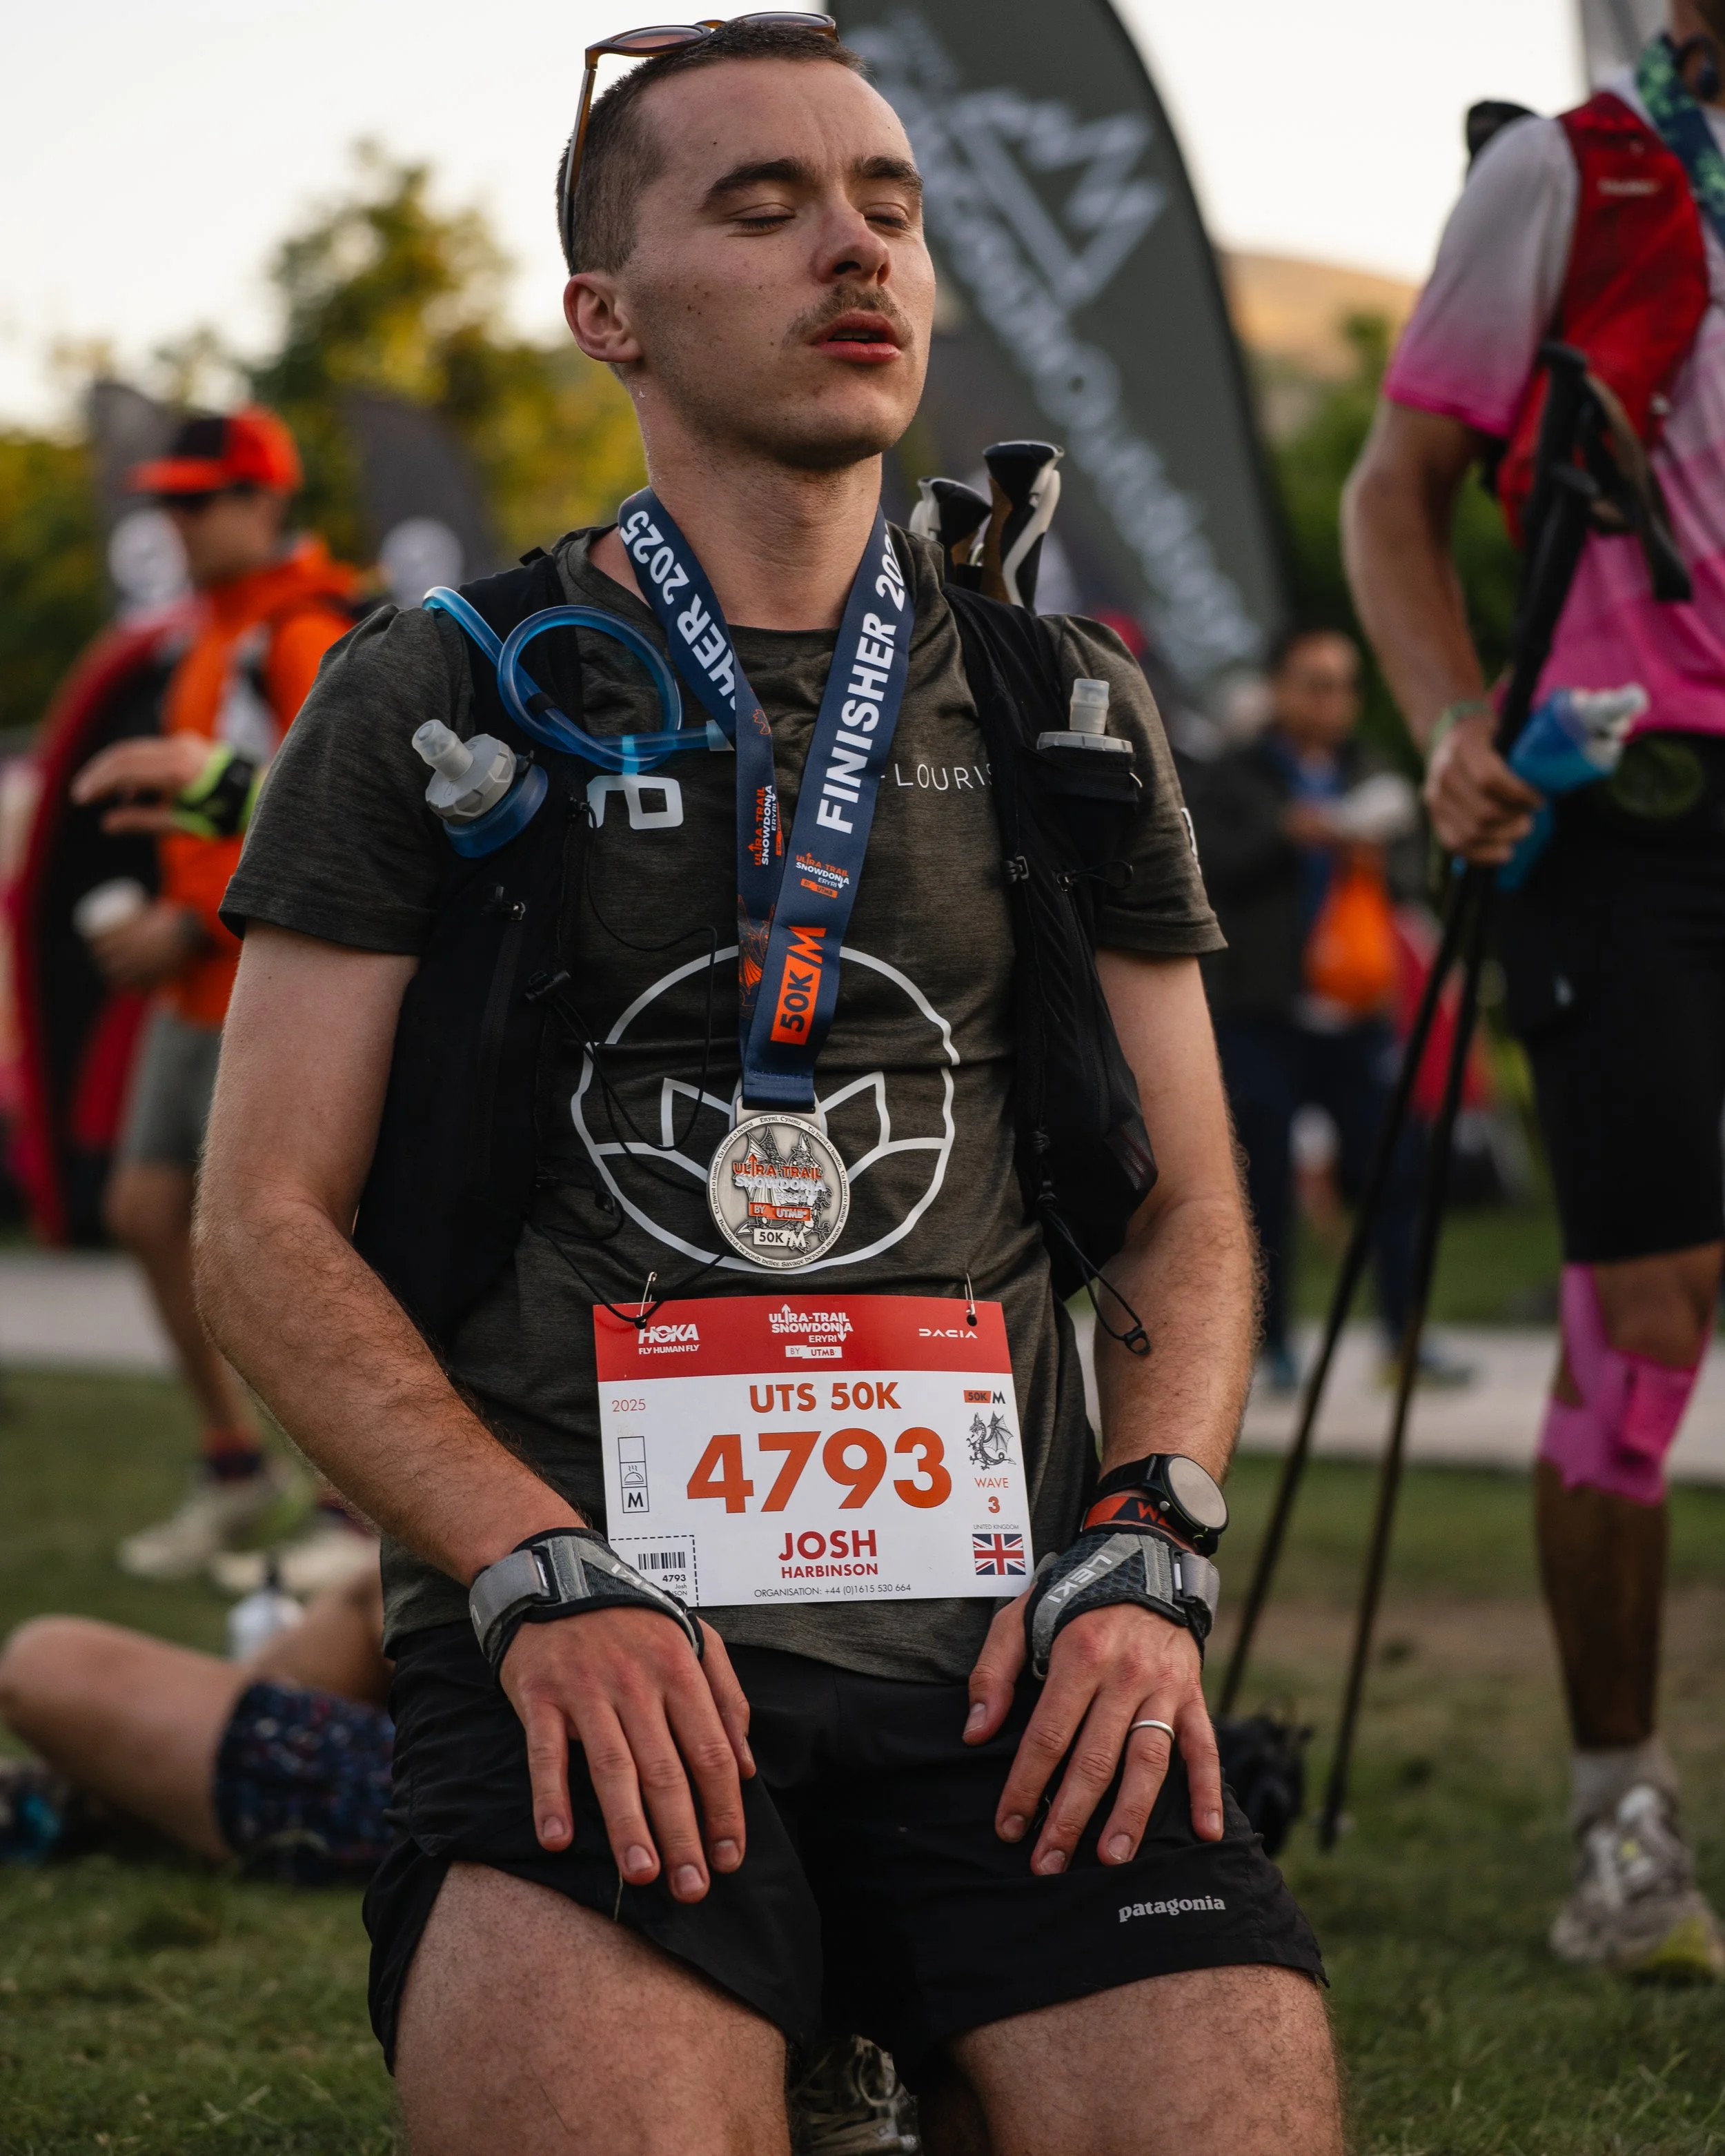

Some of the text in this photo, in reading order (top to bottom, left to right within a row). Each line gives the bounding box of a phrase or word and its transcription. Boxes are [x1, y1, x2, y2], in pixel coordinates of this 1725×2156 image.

[620, 511, 736, 711] HER 2025
[816, 520, 905, 834] FINISHER 202
[880, 763, 992, 791] LOURI
[761, 785, 774, 866] SNOWDONIA
[795, 862, 850, 887] SNOWDONIA
[780, 969, 814, 1033] 50K
[733, 1158, 822, 1180] ULTRA-TRAIL
[754, 1205, 766, 1214] BY
[759, 1231, 785, 1243] 50K
[768, 1307, 849, 1324] ULTRA-TRAIL
[638, 1323, 700, 1345] HOKA
[771, 1323, 854, 1336] SNOWDONIA
[918, 1328, 978, 1338] DACIA
[638, 1347, 652, 1355] FLY
[653, 1345, 686, 1354] HUMAN
[611, 1398, 647, 1412] 2025
[749, 1381, 902, 1414] UTS 50K
[967, 1390, 1006, 1404] 50K M
[686, 1426, 952, 1514] 4793
[974, 1477, 1009, 1489] WAVE
[627, 1492, 644, 1508] M
[987, 1496, 1001, 1514] 3
[778, 1529, 878, 1561] JOSH
[662, 1574, 687, 1583] 4793
[781, 1563, 878, 1579] HARBINSON
[1046, 1554, 1114, 1604] LEKI
[753, 1583, 911, 1598] ORGANISATION: +44 (0)1615 530 664
[1118, 1895, 1226, 1923] patagonia
